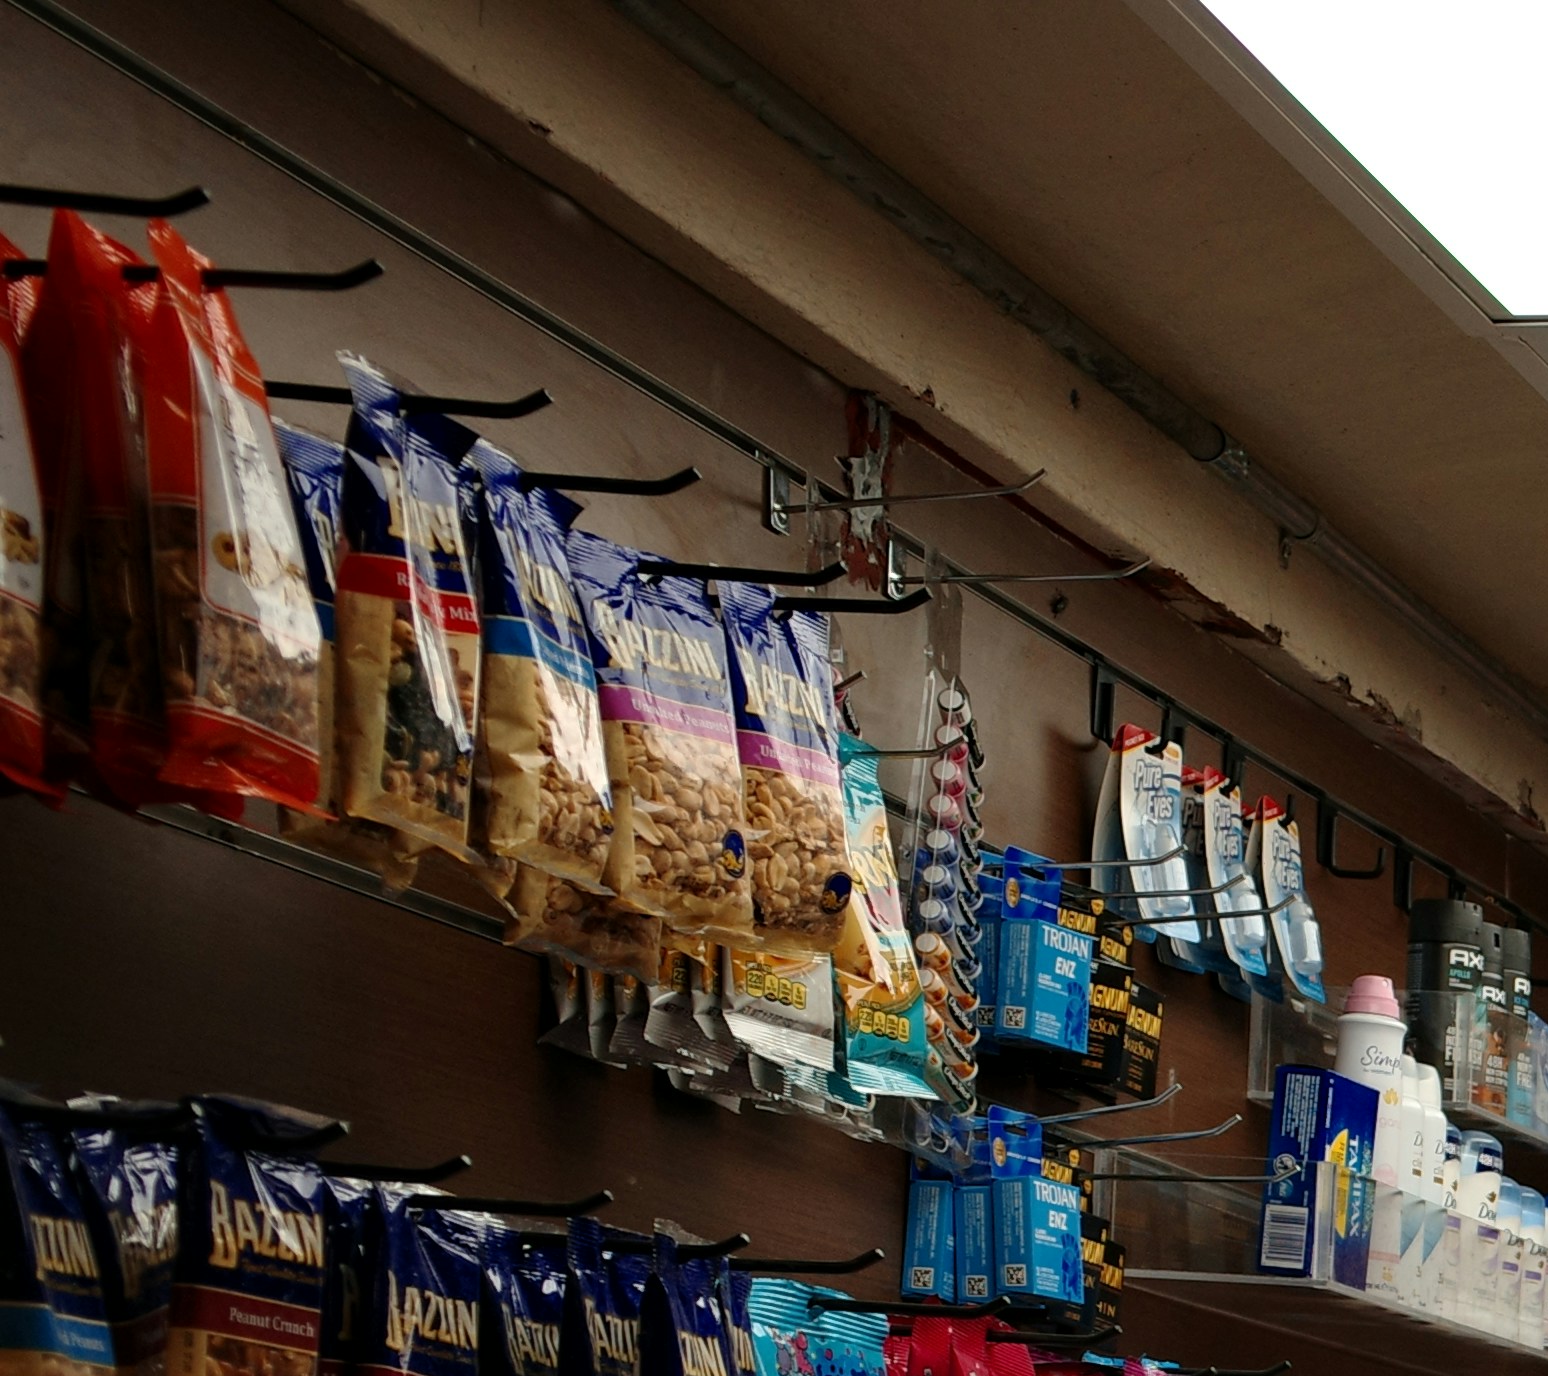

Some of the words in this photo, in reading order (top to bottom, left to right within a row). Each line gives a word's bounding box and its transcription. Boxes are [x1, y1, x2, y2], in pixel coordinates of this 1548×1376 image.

[1042, 925, 1090, 960] TROJAN
[1054, 956, 1076, 978] ENZ
[1033, 1180, 1078, 1209] TROJAN
[1047, 1211, 1068, 1232] ENZ
